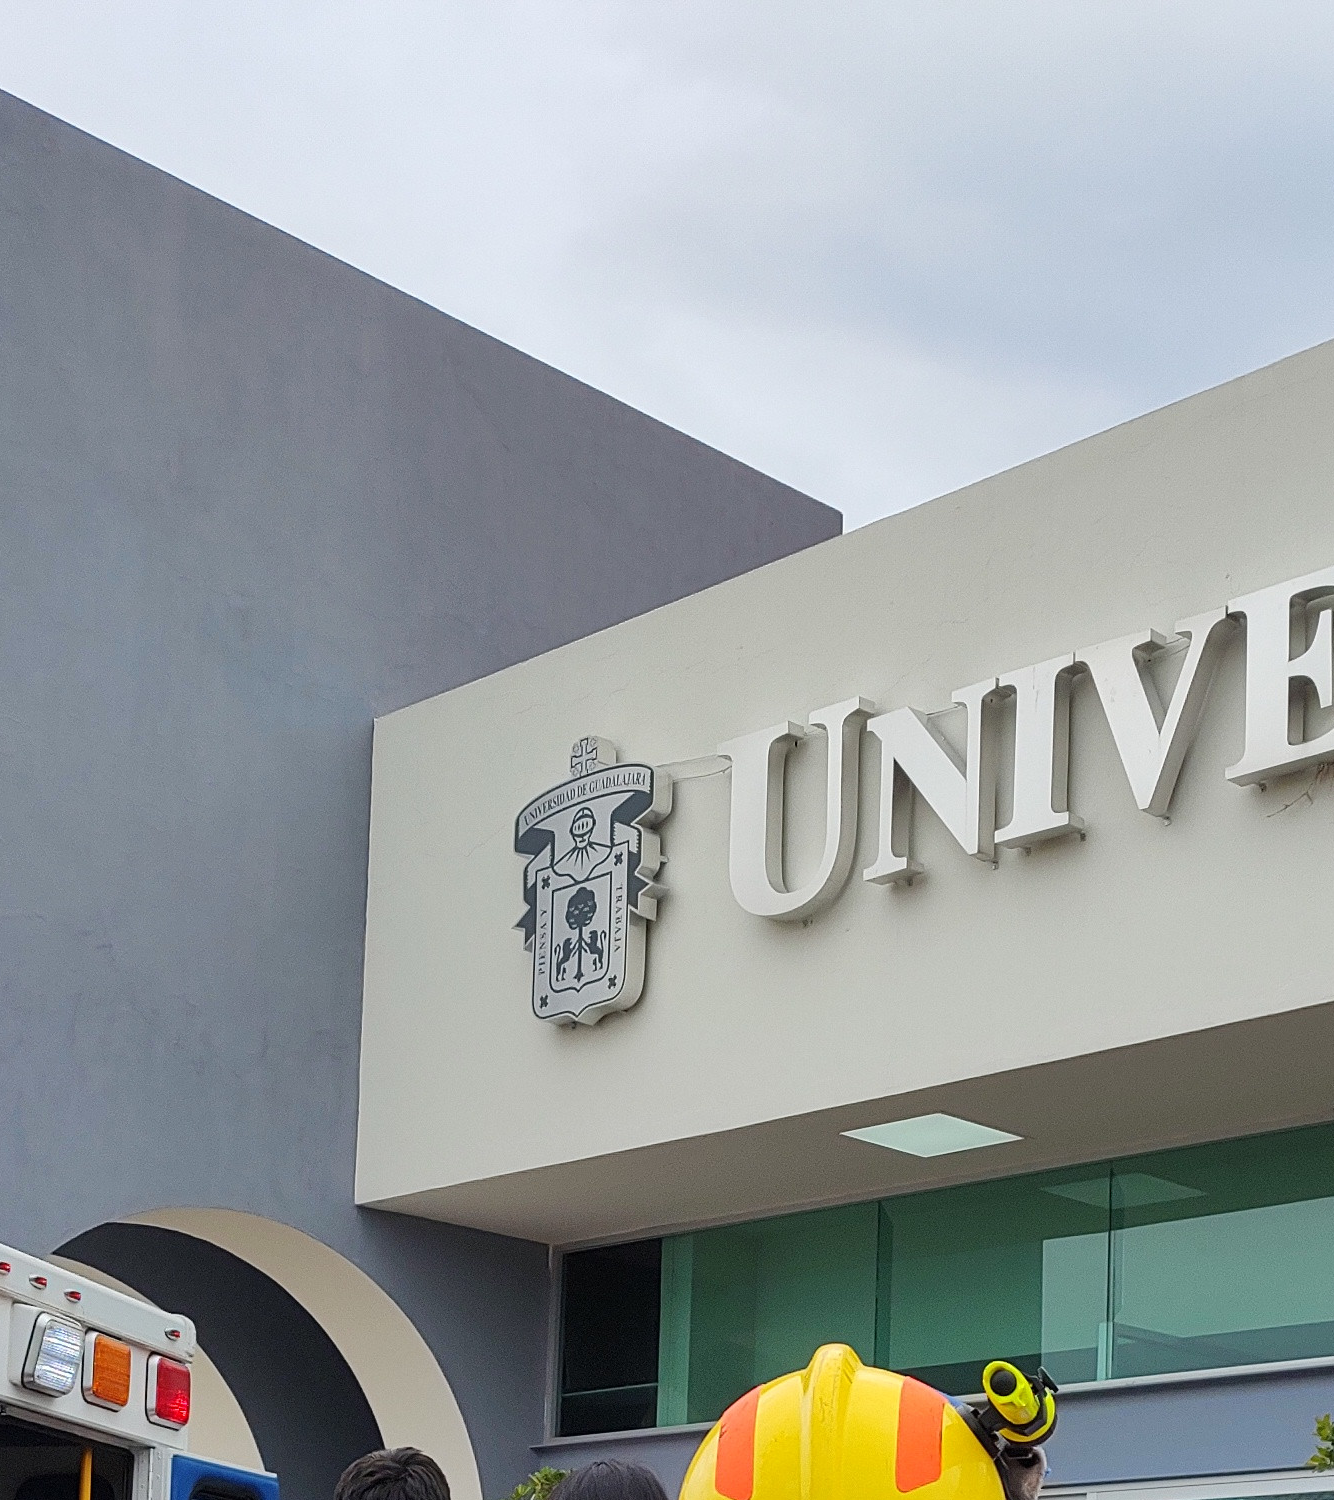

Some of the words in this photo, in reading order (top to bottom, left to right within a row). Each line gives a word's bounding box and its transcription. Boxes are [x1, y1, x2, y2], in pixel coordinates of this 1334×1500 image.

[523, 788, 576, 826] UNIVERSIDAD
[577, 782, 587, 797] DE
[589, 772, 646, 794] GUADALAJARA
[613, 882, 623, 953] TRABAJA
